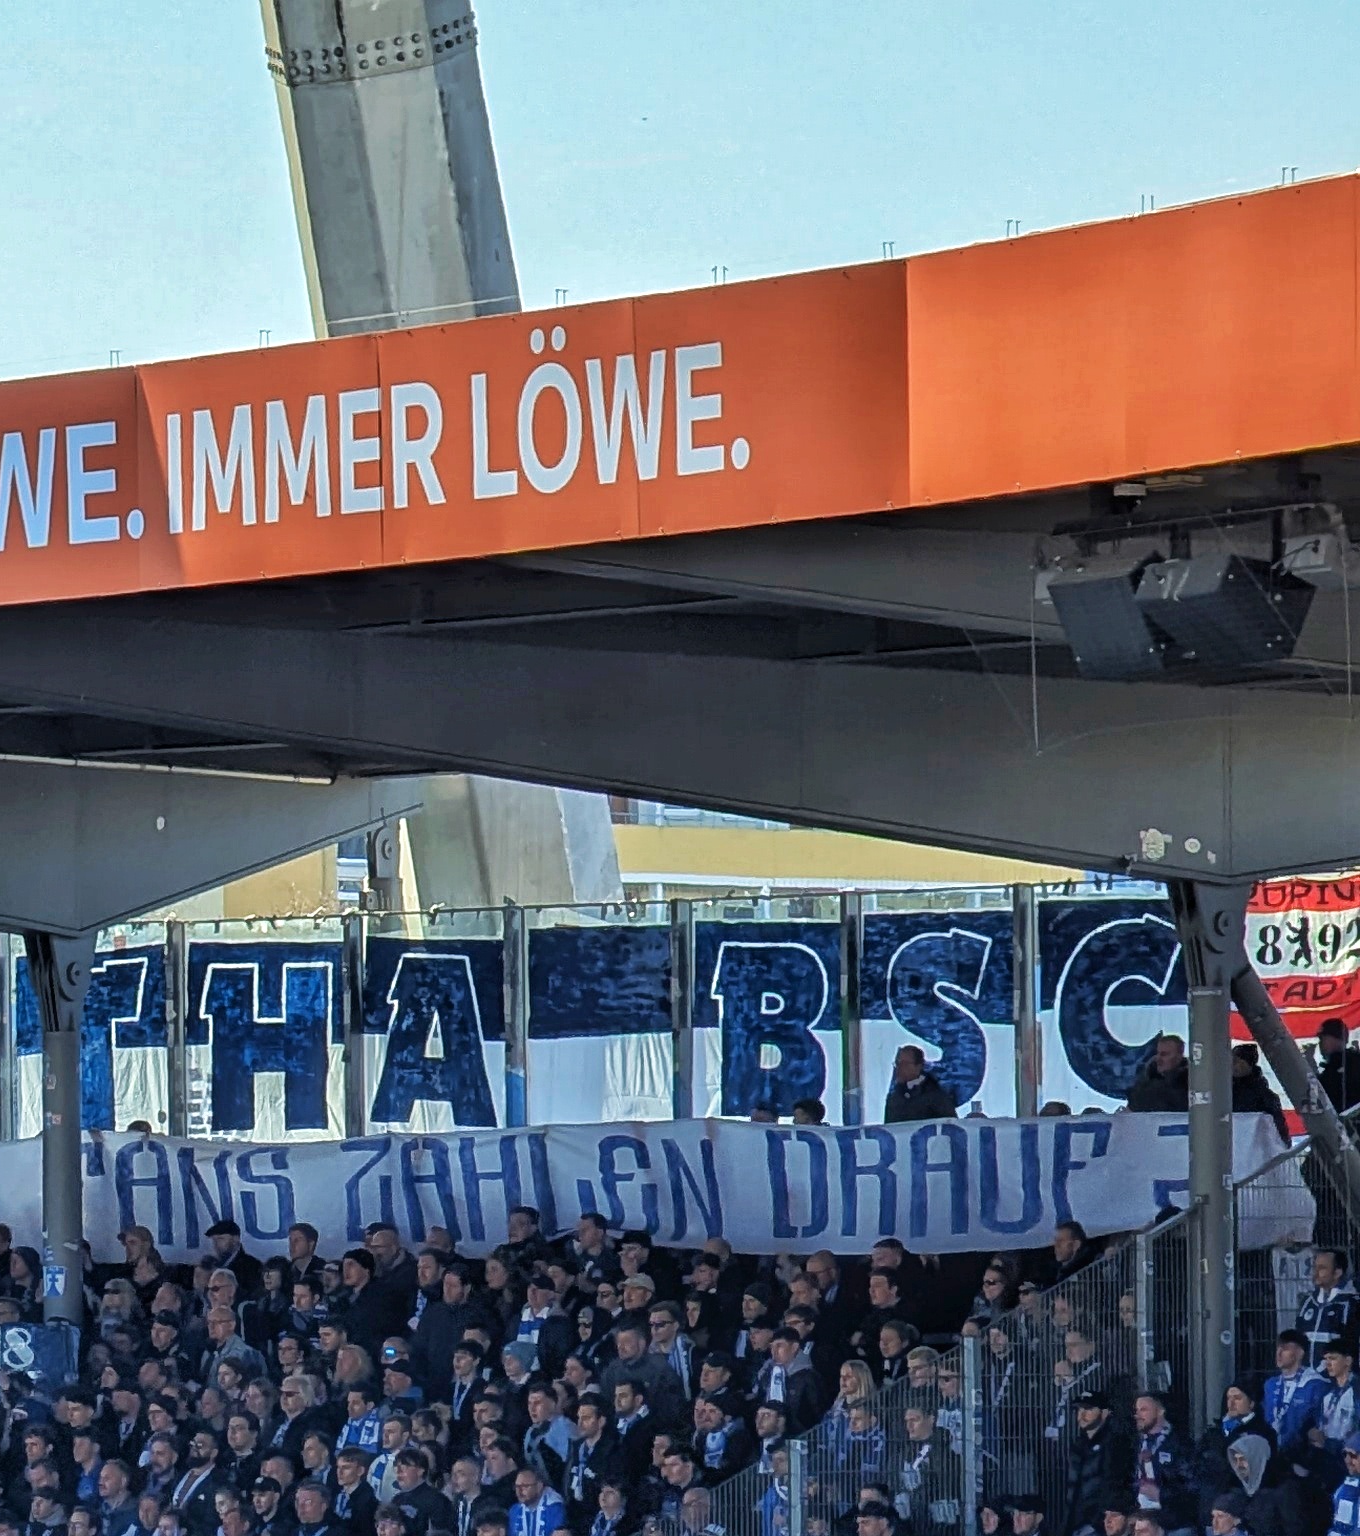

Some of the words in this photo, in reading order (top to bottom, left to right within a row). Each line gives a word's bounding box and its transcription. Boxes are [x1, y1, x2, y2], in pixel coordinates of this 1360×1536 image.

[167, 381, 445, 534] IMMER
[471, 326, 750, 501] LÖWE.
[712, 914, 1182, 1118] BSC
[346, 1130, 723, 1246] ZAHLEN
[769, 1119, 1111, 1240] DRAUF
